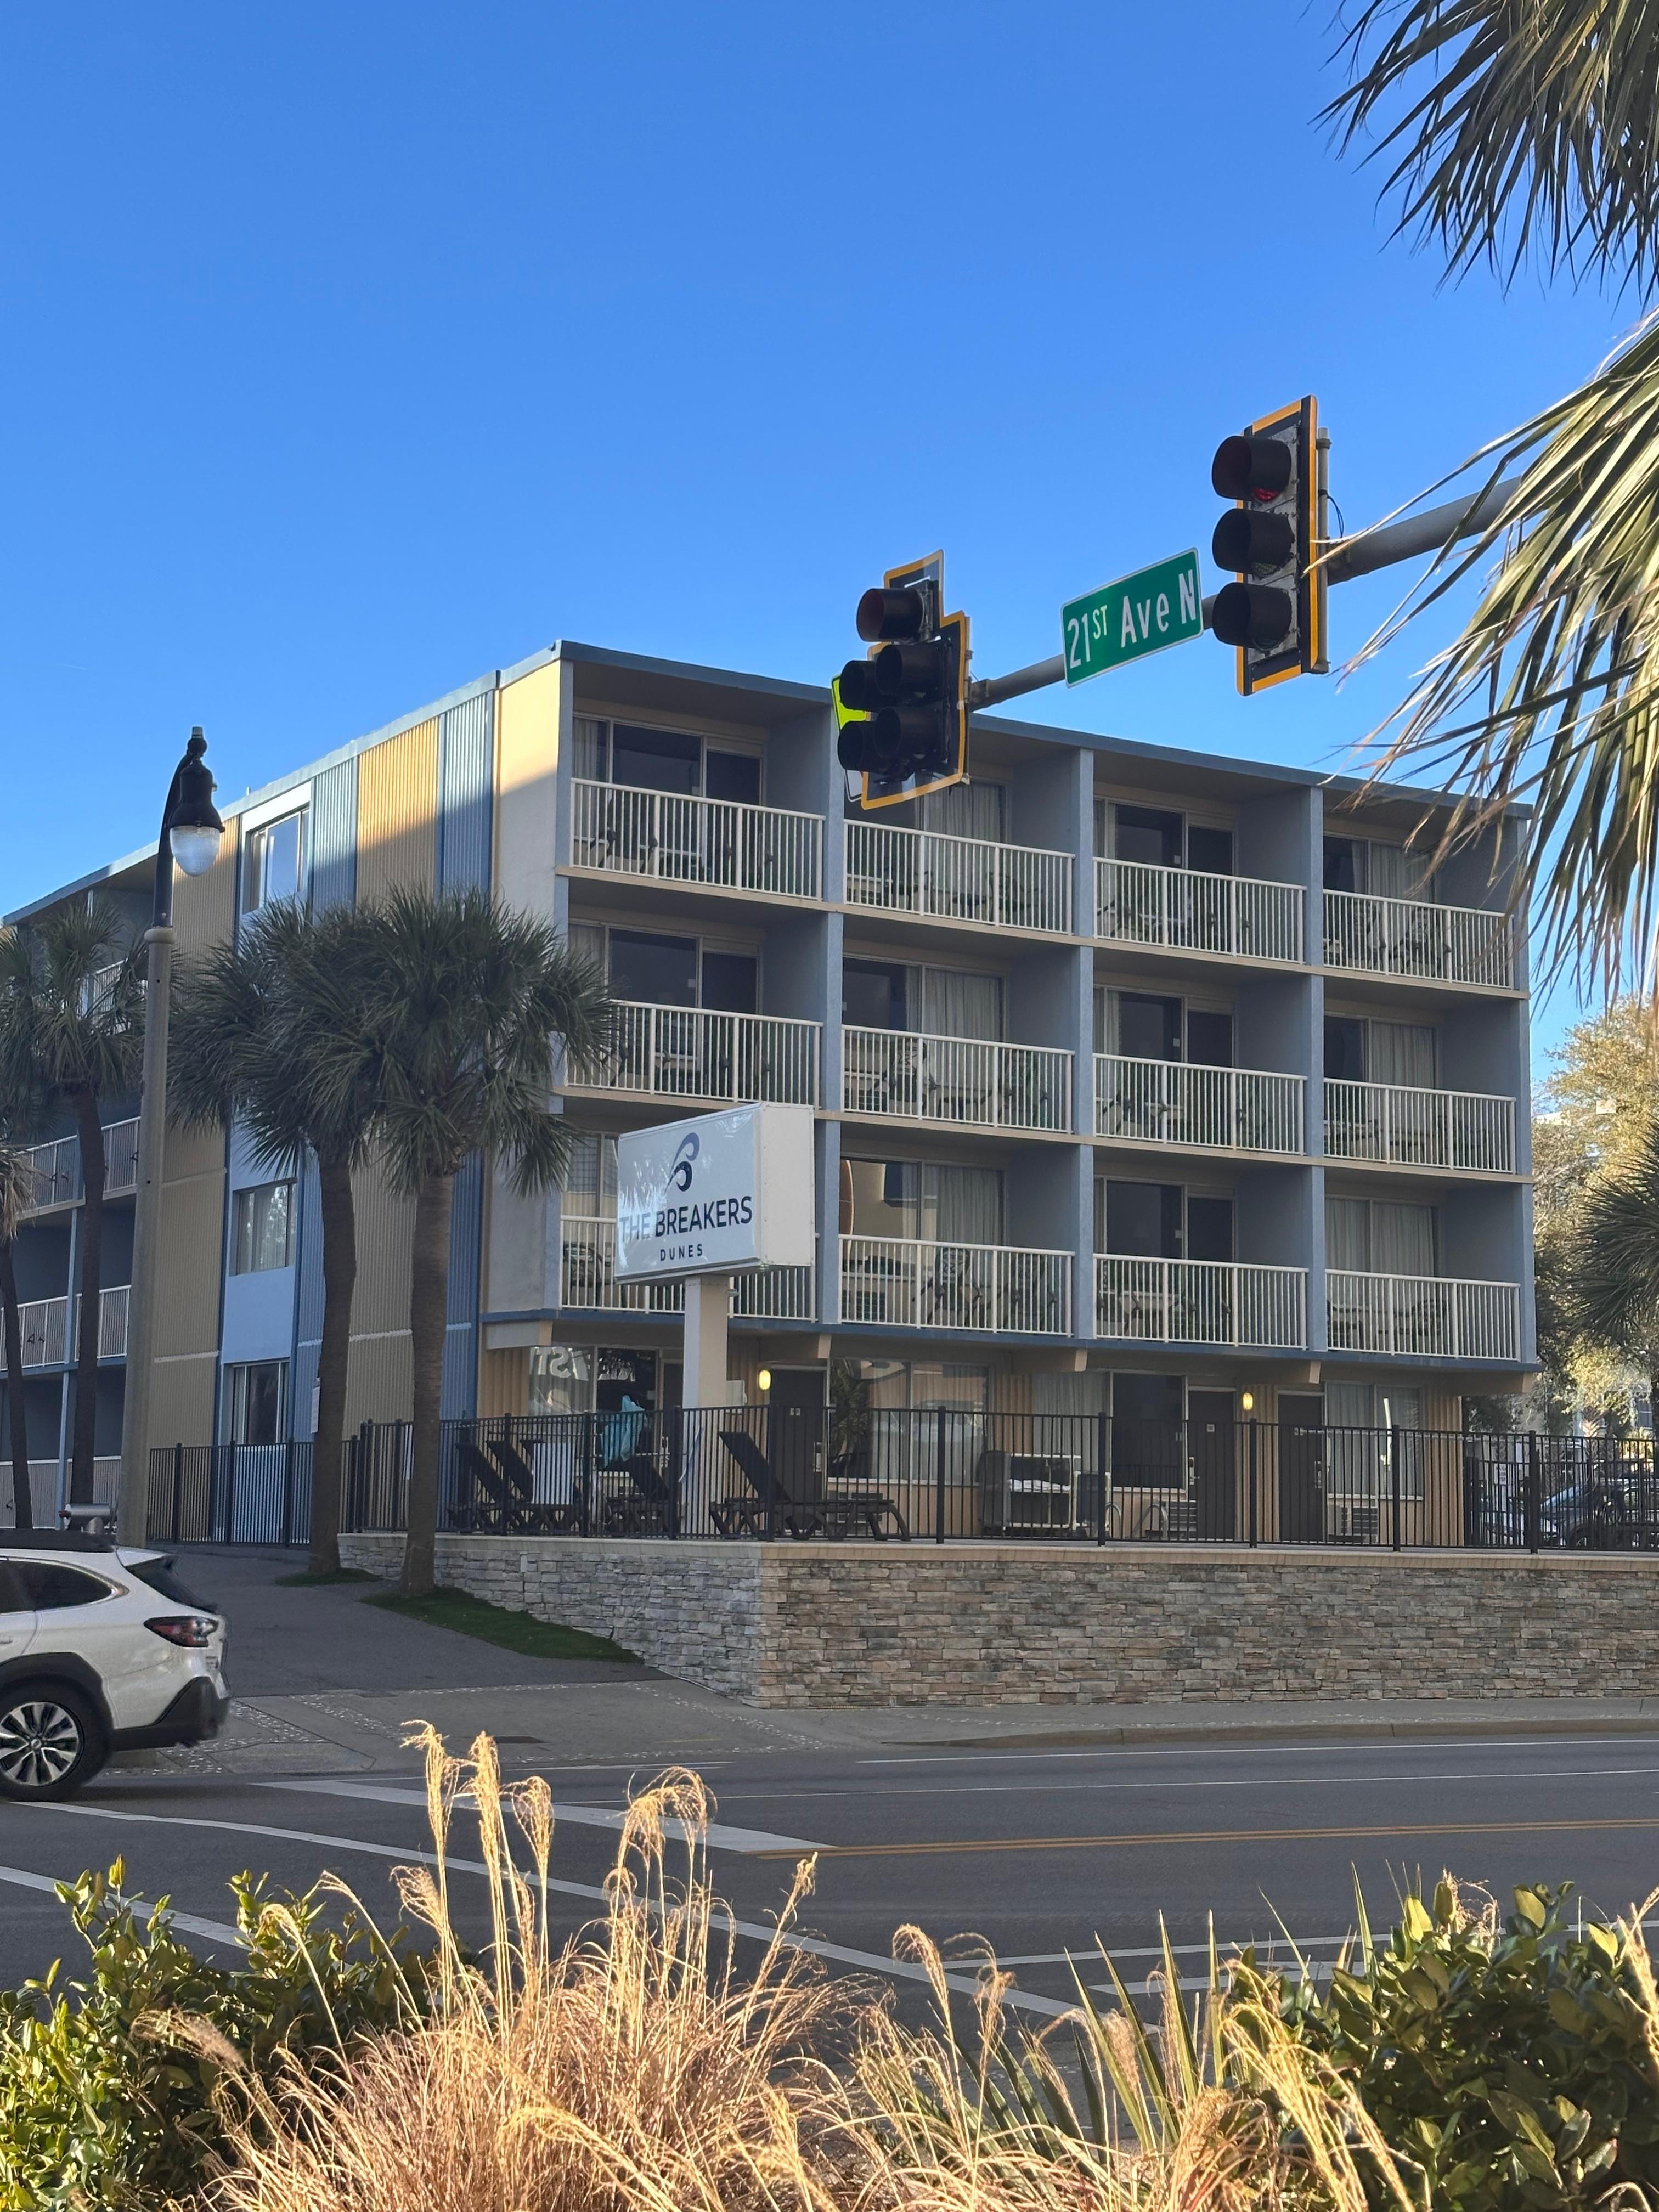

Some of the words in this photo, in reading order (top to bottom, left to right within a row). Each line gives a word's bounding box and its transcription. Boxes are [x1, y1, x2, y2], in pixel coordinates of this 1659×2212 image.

[1067, 605, 1108, 669] 21ST
[1121, 592, 1170, 648] Ave
[1178, 569, 1197, 624] N
[619, 1212, 651, 1243] THE
[655, 1195, 753, 1238] BREAKERS
[660, 1244, 703, 1262] DUNES
